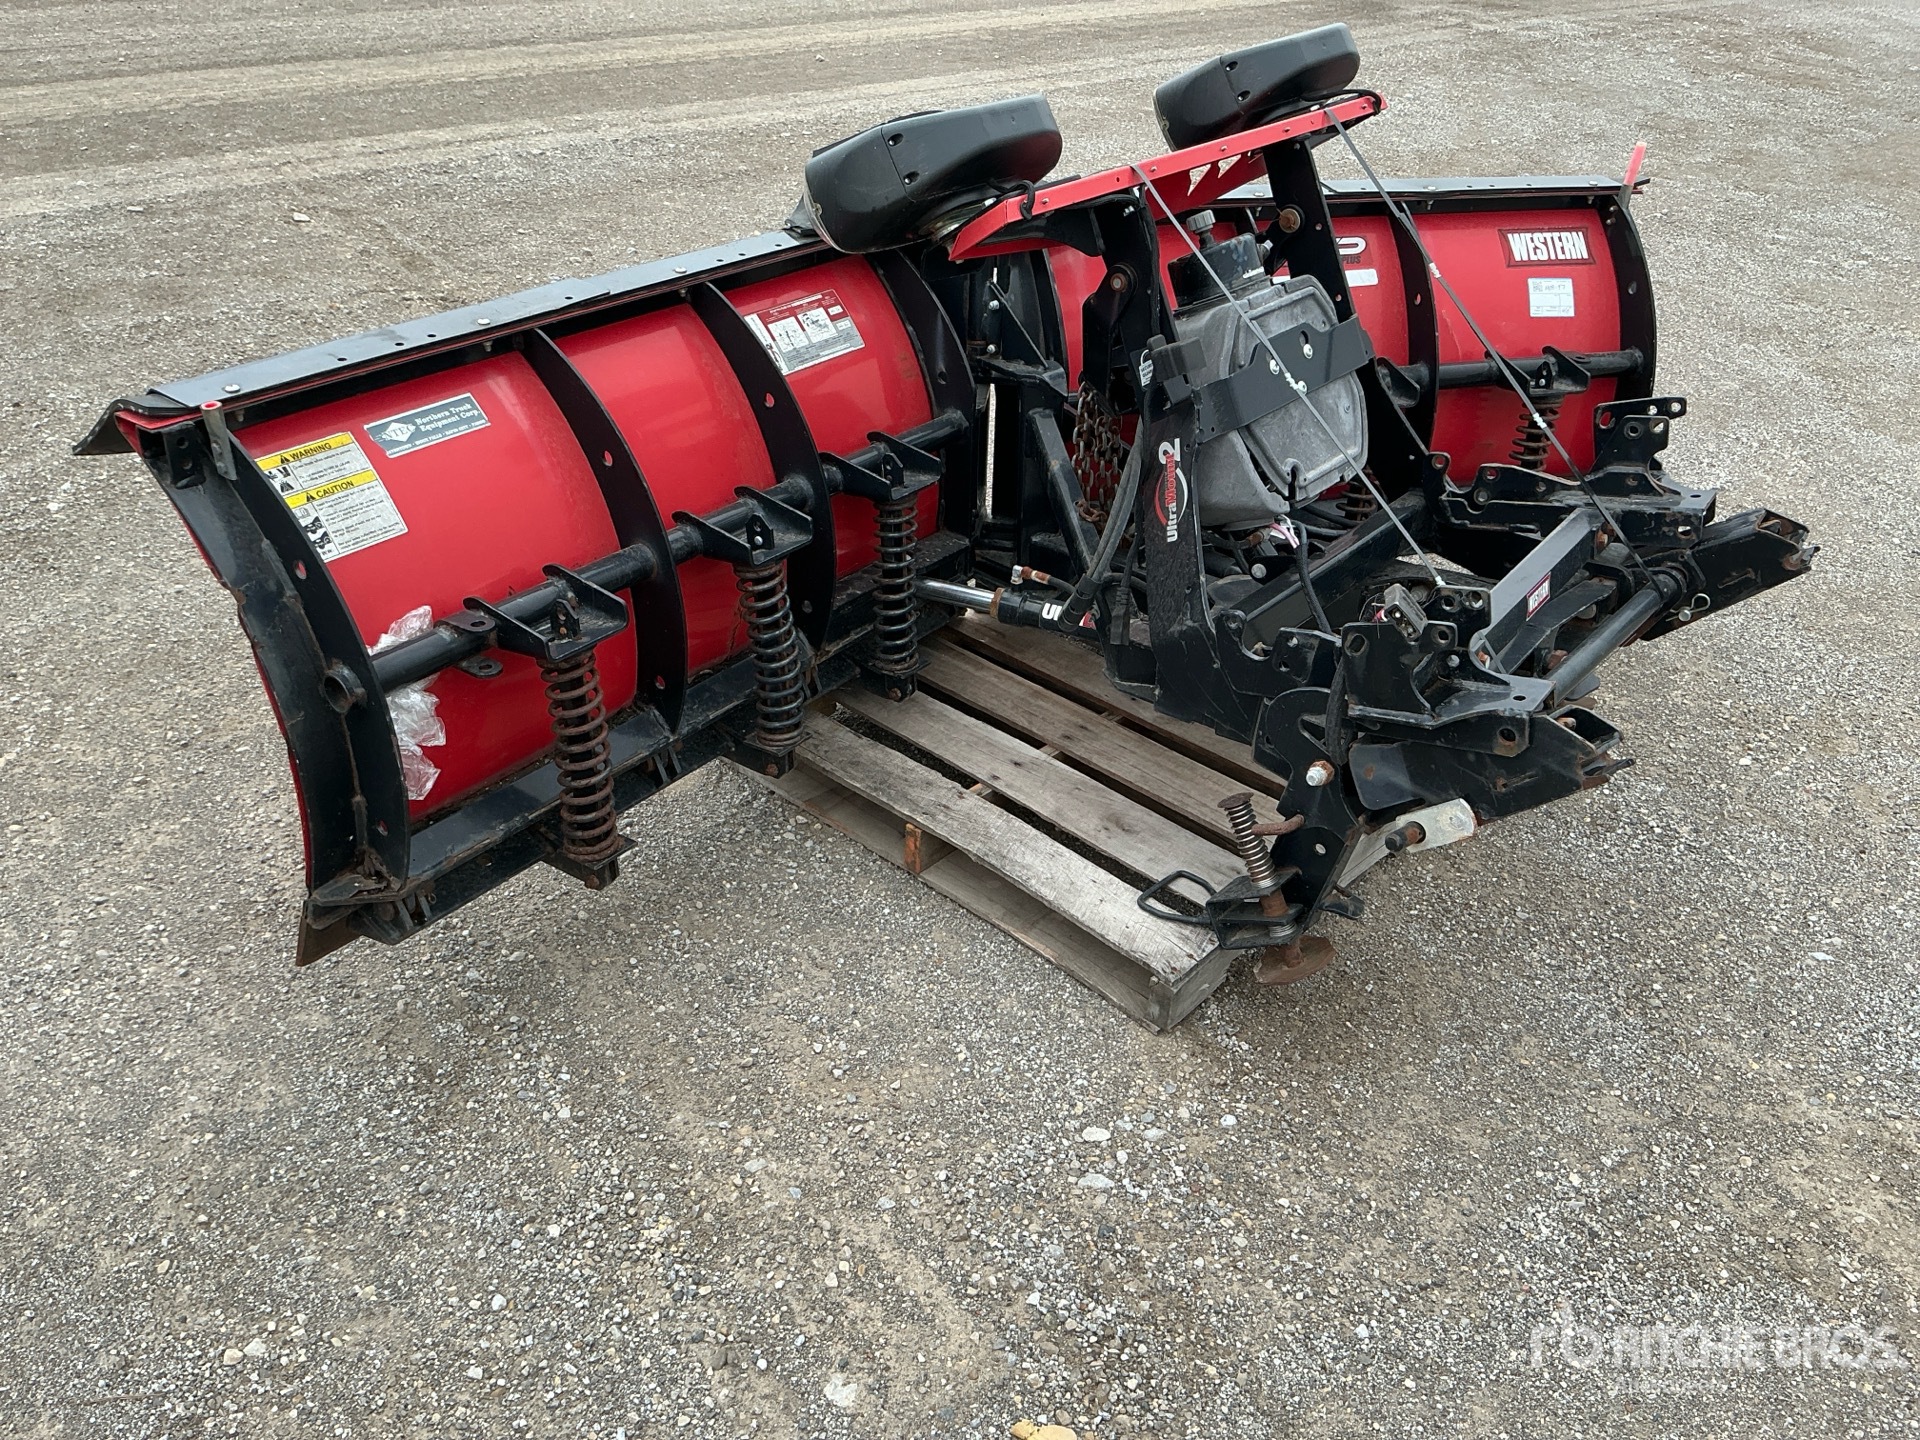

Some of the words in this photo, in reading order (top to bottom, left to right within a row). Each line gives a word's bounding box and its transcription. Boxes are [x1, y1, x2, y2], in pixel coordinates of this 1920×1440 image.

[1507, 231, 1589, 262] WESTERN
[1341, 255, 1362, 264] PLUS
[415, 410, 450, 426] Northern
[449, 403, 472, 414] Truck
[419, 416, 460, 432] Equipment
[460, 410, 481, 419] Corp.
[289, 443, 333, 461] WARNING
[1158, 438, 1181, 465] 2
[316, 480, 355, 498] CAUTION
